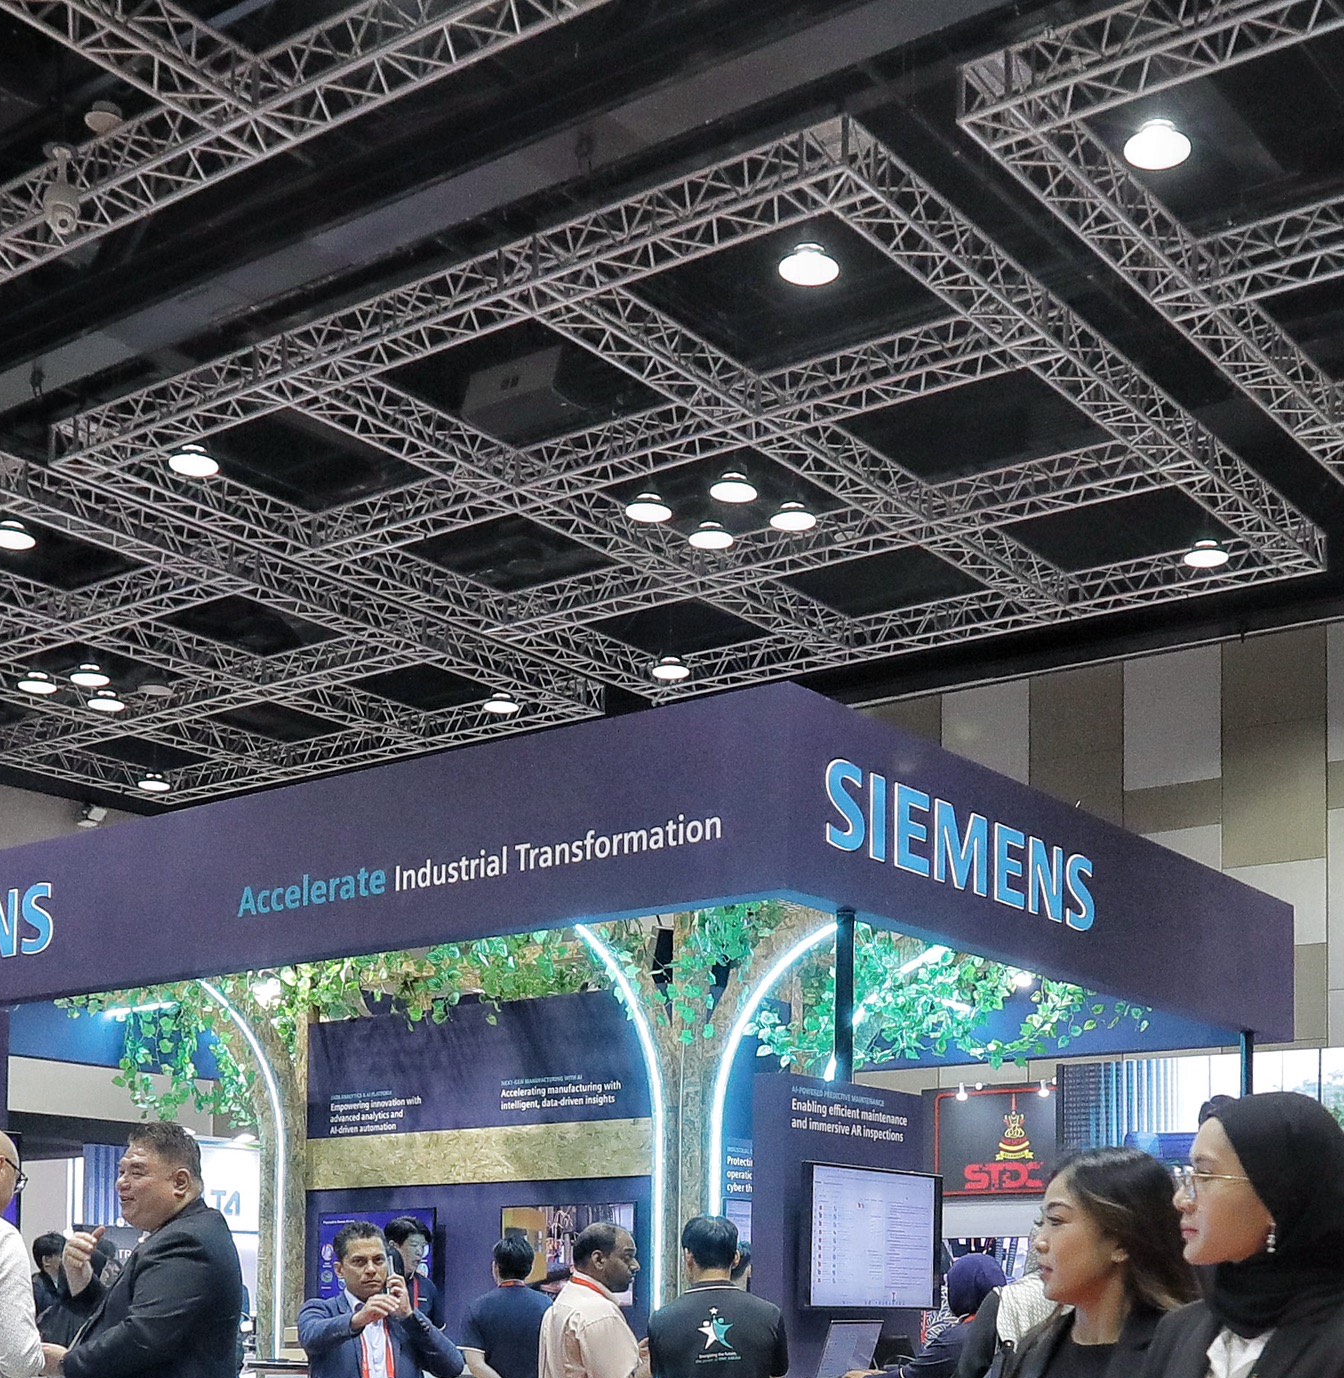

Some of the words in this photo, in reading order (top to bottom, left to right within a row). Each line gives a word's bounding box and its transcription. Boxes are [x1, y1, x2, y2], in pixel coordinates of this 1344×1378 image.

[825, 758, 1095, 932] SIEMENS
[238, 866, 387, 917] Accelerate
[394, 846, 508, 892] Industrial
[514, 813, 722, 873] Transformation
[501, 1086, 546, 1098] Accelerating
[547, 1083, 602, 1095] manufacturing
[604, 1081, 621, 1090] with
[330, 1101, 369, 1112] Empowering
[370, 1097, 405, 1107] innovation
[406, 1095, 422, 1105] with
[501, 1100, 540, 1111] intelligent,
[541, 1096, 584, 1107] data-driven
[585, 1095, 615, 1106] insights
[330, 1113, 360, 1123] advanced
[361, 1110, 389, 1121] analytics
[391, 1109, 404, 1118] and
[791, 1098, 827, 1117] Enabling
[829, 1103, 860, 1120] efficient
[861, 1109, 908, 1126] maintenance
[330, 1124, 358, 1134] AI-driven
[359, 1122, 397, 1132] automation
[791, 1117, 807, 1130] and
[809, 1118, 850, 1135] immersive
[851, 1124, 862, 1137] AR
[863, 1126, 904, 1142] inspections
[726, 1182, 743, 1194] cyber
[743, 1183, 753, 1193] th
